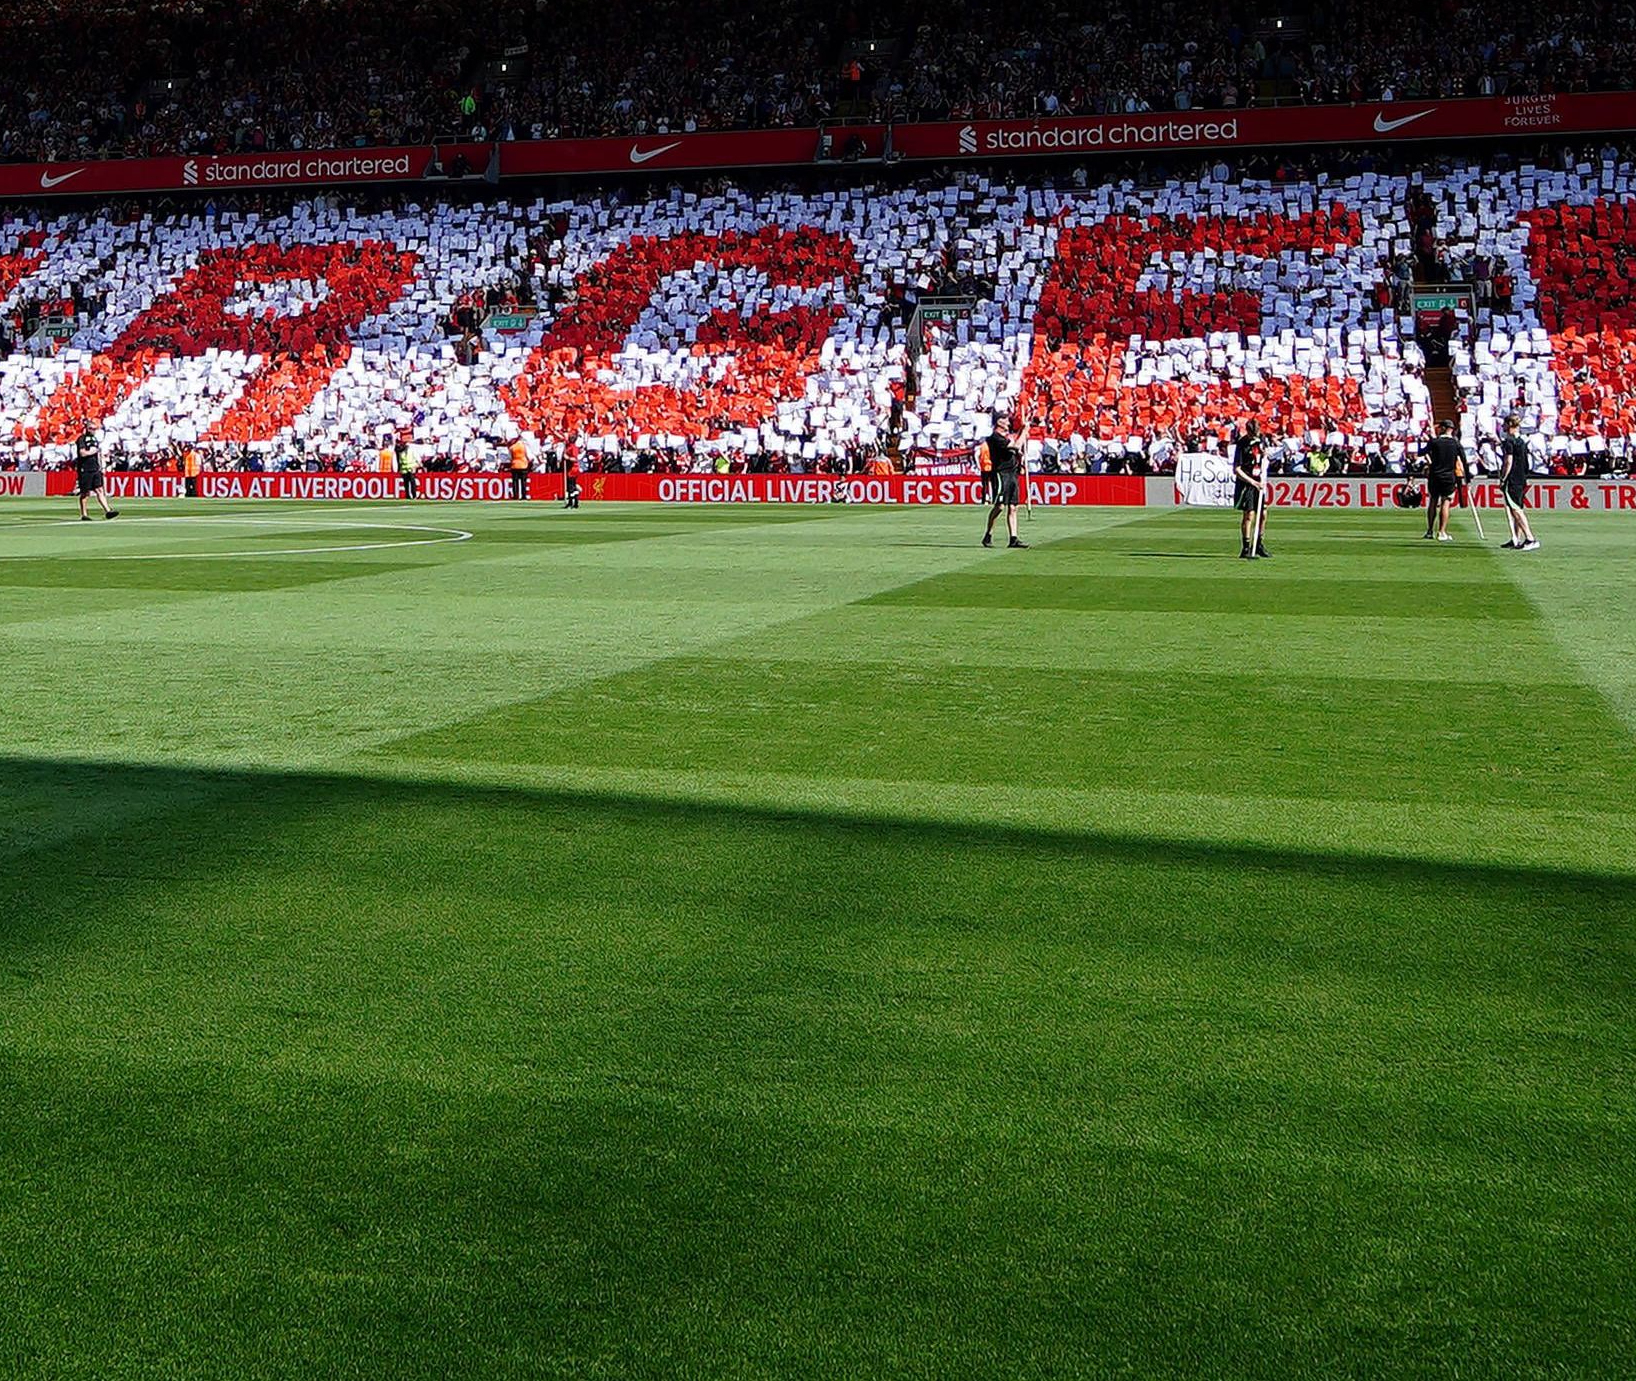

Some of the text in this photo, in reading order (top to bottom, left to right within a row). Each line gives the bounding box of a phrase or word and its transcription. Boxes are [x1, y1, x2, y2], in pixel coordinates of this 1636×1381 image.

[1504, 115, 1561, 127] FOREVER
[1515, 104, 1551, 116] LIVES
[986, 119, 1237, 149] standard chartered
[205, 155, 409, 181] standard chartered
[1180, 460, 1202, 483] He
[104, 477, 129, 497] UY
[134, 477, 154, 497] IN
[158, 477, 185, 497] TH
[203, 477, 243, 498] USA
[248, 477, 275, 498] AT
[659, 479, 760, 502] OFFICIAL
[766, 479, 897, 502] LIVEROOL
[904, 480, 933, 503] FC
[1029, 482, 1077, 504] APP
[1264, 483, 1351, 507] 024/25
[1570, 485, 1589, 508] &
